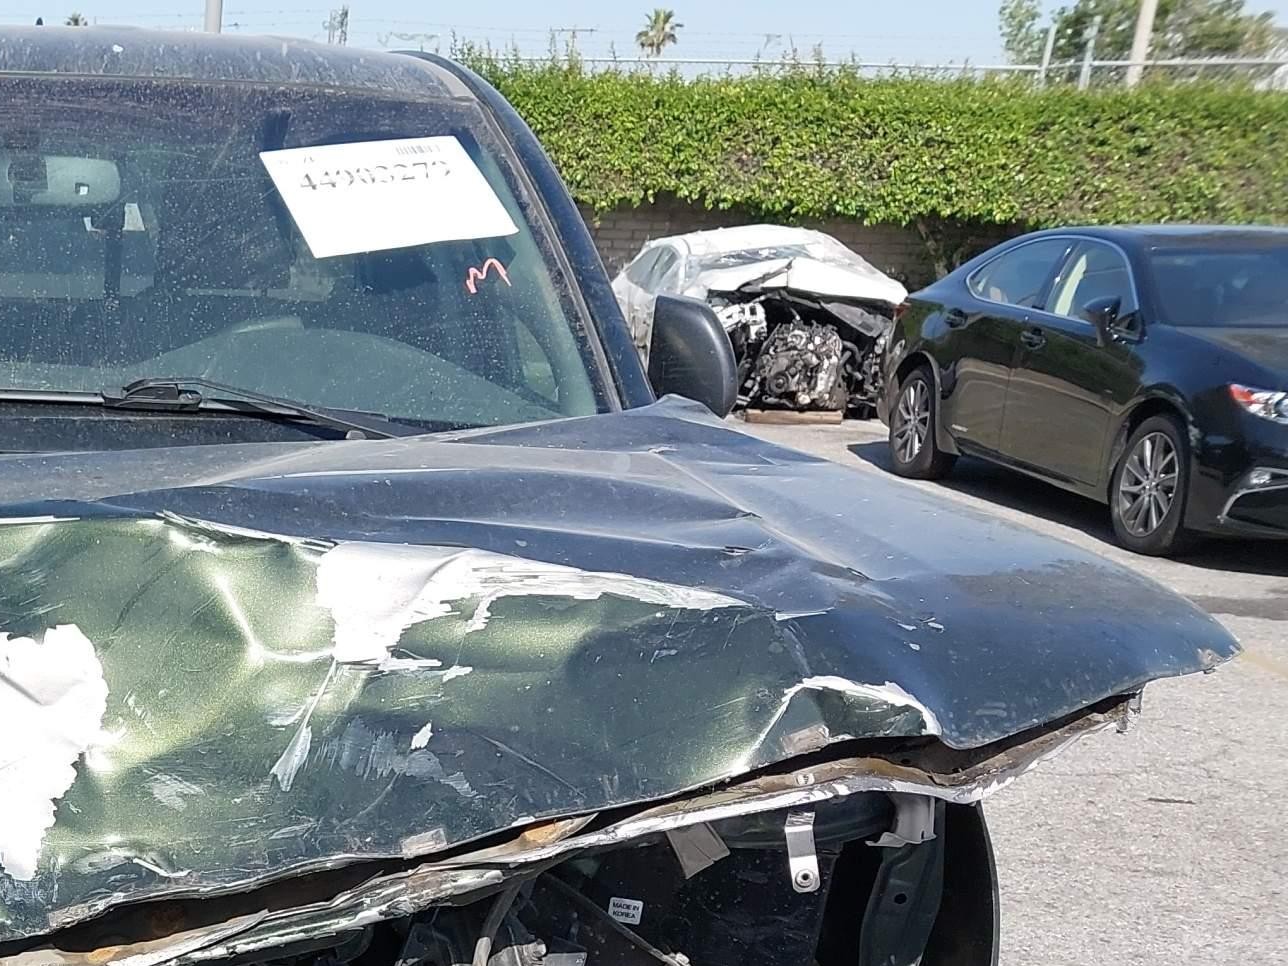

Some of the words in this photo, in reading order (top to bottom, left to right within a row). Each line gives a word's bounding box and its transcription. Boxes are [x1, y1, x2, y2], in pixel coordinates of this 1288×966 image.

[612, 901, 632, 911] MADE
[632, 904, 640, 912] IN
[612, 910, 636, 919] KOREA
